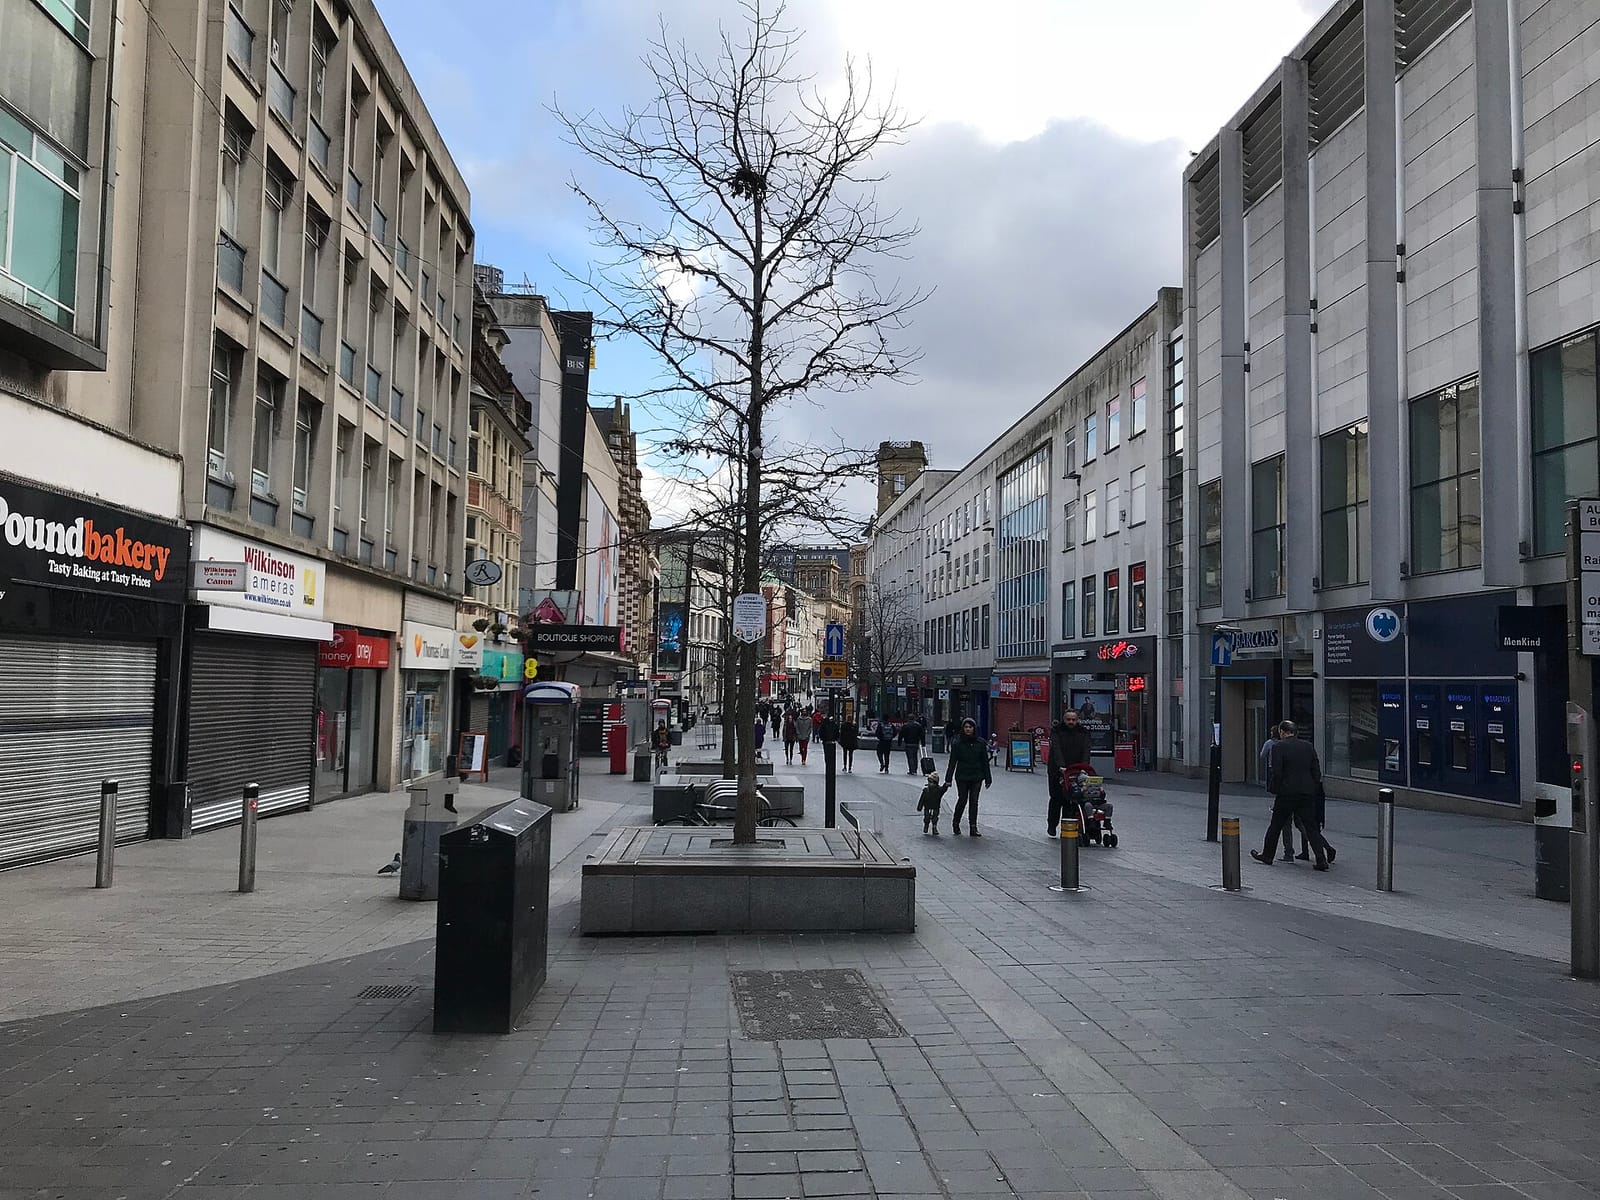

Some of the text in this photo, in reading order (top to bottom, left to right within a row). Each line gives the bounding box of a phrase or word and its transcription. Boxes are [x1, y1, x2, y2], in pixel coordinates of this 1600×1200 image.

[567, 360, 584, 368] BHS
[1590, 517, 1600, 526] B
[244, 546, 295, 580] Wilkinson
[48, 559, 151, 588] Tasty Baking at Tasty Prices
[206, 578, 233, 586] Canon
[253, 575, 295, 596] ameras
[244, 593, 291, 608] www.wilkinson.co.uk
[537, 633, 616, 643] BOUTIQUE SHOPPING
[1503, 636, 1541, 647] MenKind
[355, 644, 372, 664] oney
[423, 641, 440, 659] Thomas
[320, 653, 351, 662] money
